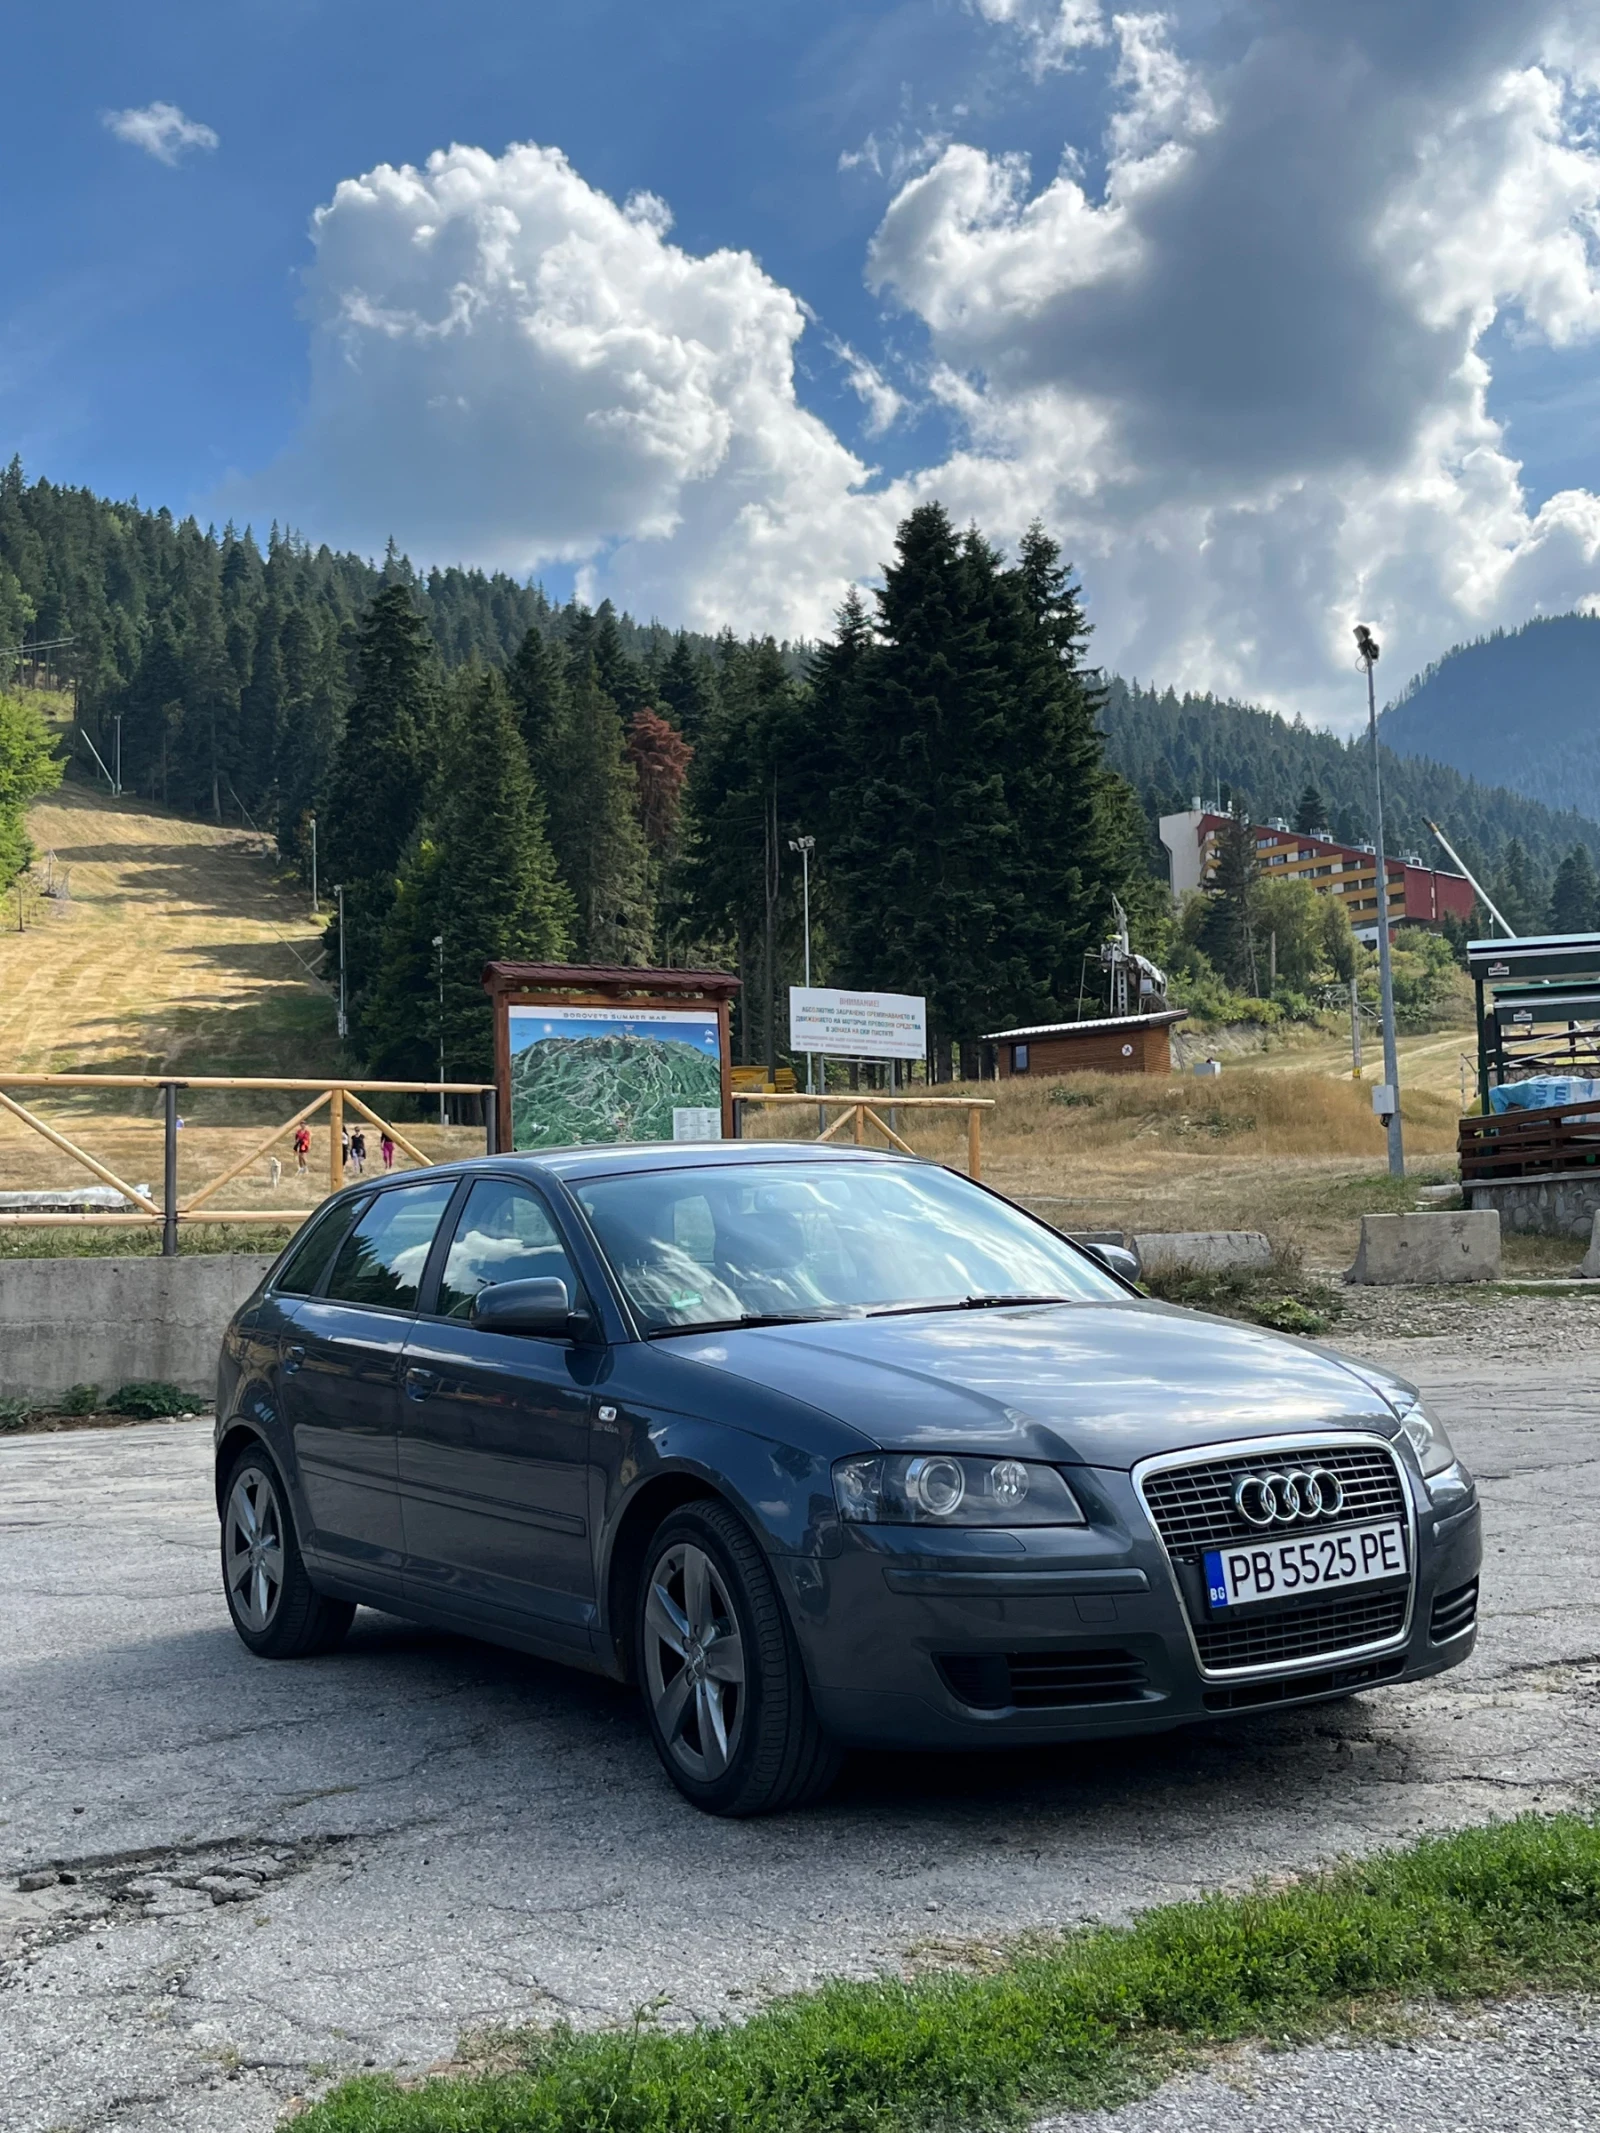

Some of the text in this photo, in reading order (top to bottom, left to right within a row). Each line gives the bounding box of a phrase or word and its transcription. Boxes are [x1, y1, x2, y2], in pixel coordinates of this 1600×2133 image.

[1228, 1529, 1400, 1597] PB 5525 PE
[1210, 1586, 1226, 1601] BG
